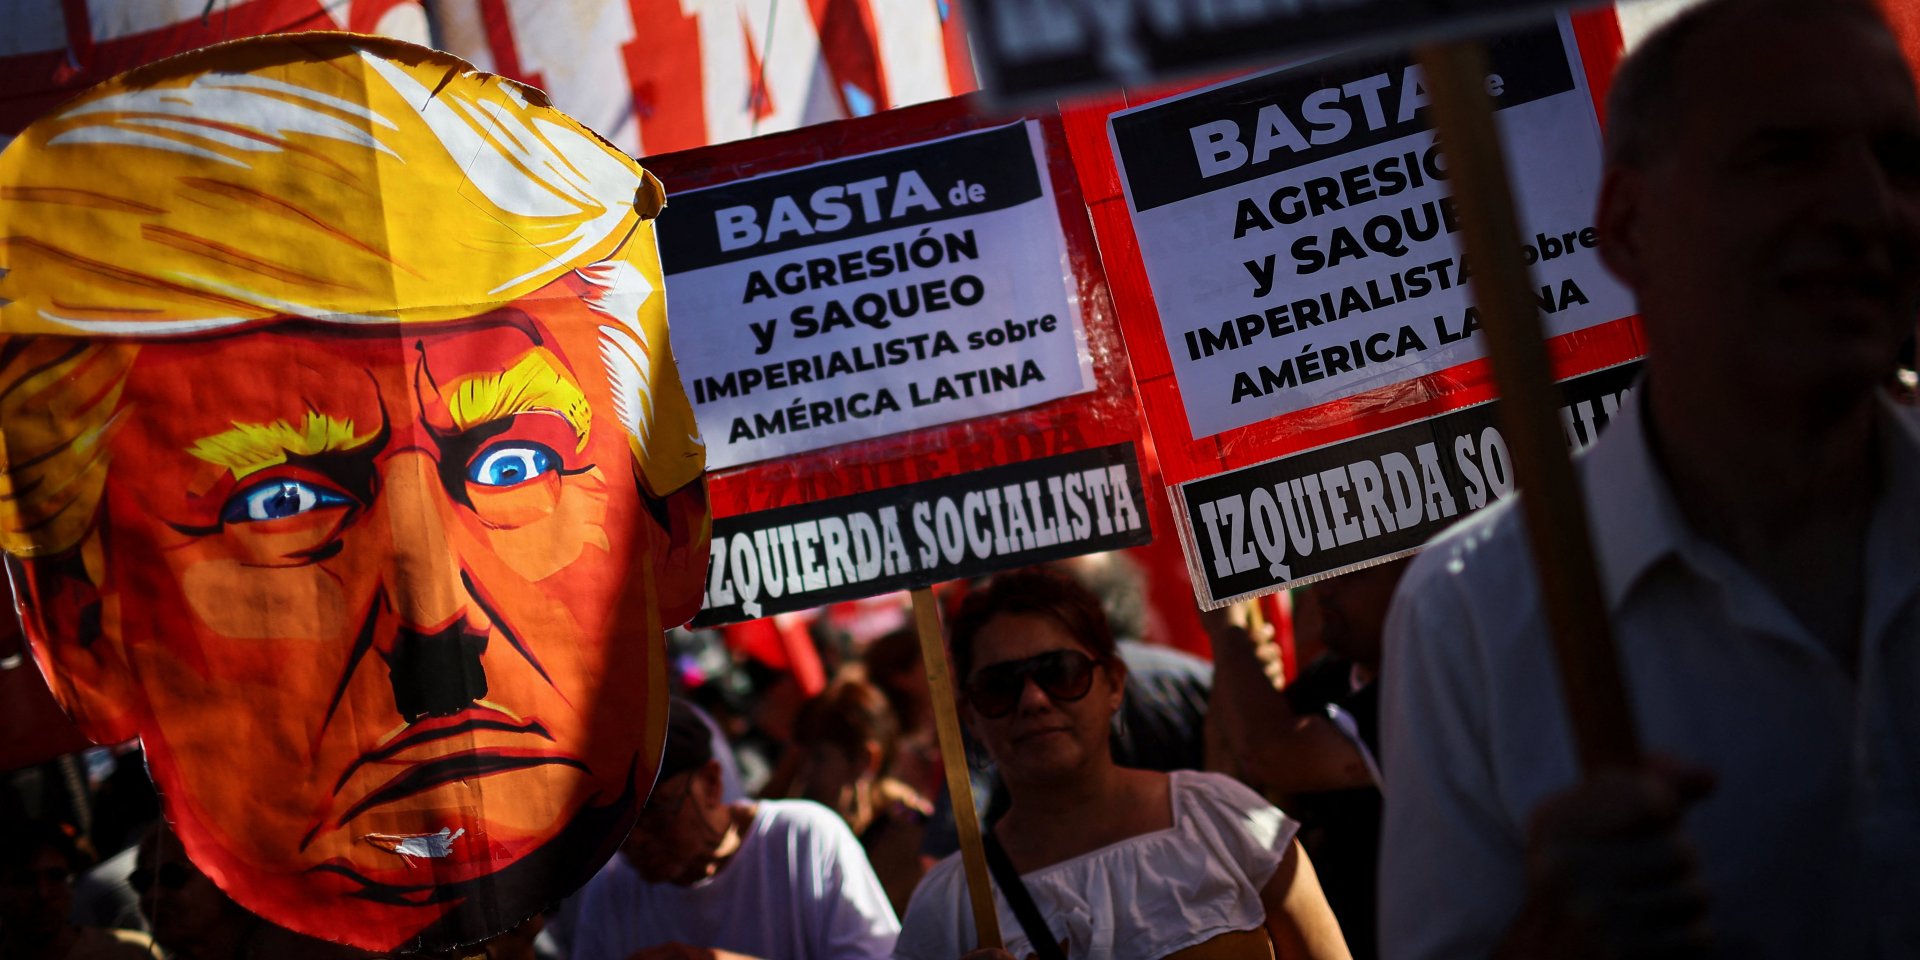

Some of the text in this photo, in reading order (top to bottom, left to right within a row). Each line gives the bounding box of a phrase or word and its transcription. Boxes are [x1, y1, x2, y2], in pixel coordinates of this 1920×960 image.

[1189, 64, 1434, 179] BASTA
[714, 169, 986, 253] BASTA de
[1244, 196, 1461, 298] y SAQUE
[1520, 226, 1600, 266] obre
[742, 228, 979, 304] AGRESIÓN
[749, 275, 985, 355] y SAQUEO
[693, 314, 1058, 406] IMPERIALISTA sobre
[728, 359, 1046, 445] AMÉRICA LATINA
[1231, 324, 1428, 404] AMÉRICA
[912, 464, 1142, 568] SOCIALISTA
[1199, 442, 1458, 582] IZQUIERDA
